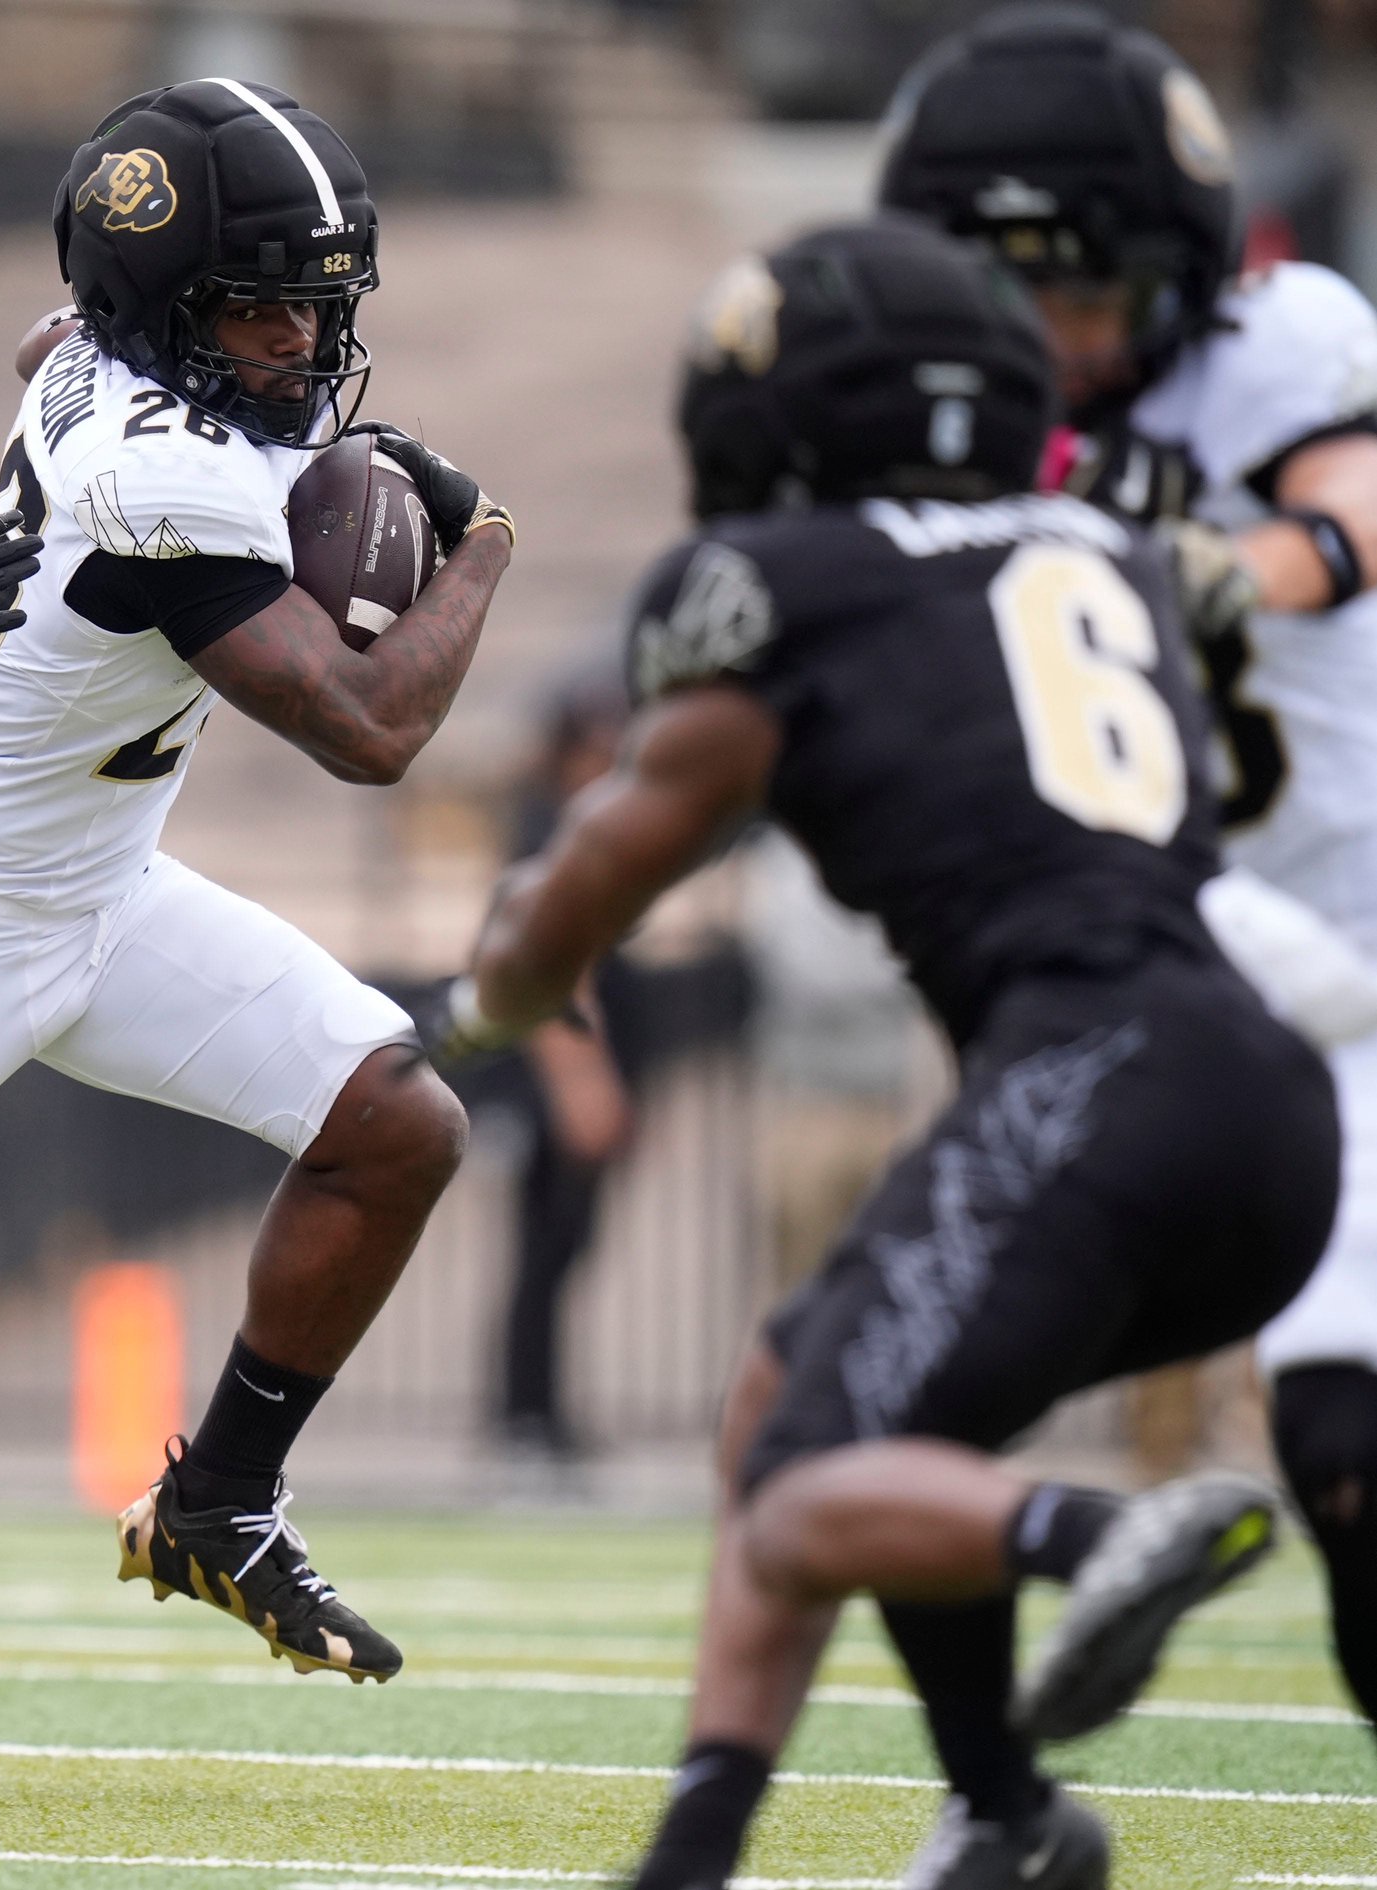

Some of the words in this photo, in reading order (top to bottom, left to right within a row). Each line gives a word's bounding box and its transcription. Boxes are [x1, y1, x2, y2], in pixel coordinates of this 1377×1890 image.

[108, 152, 154, 215] CU
[323, 252, 351, 274] S2S
[986, 543, 1189, 849] 6
